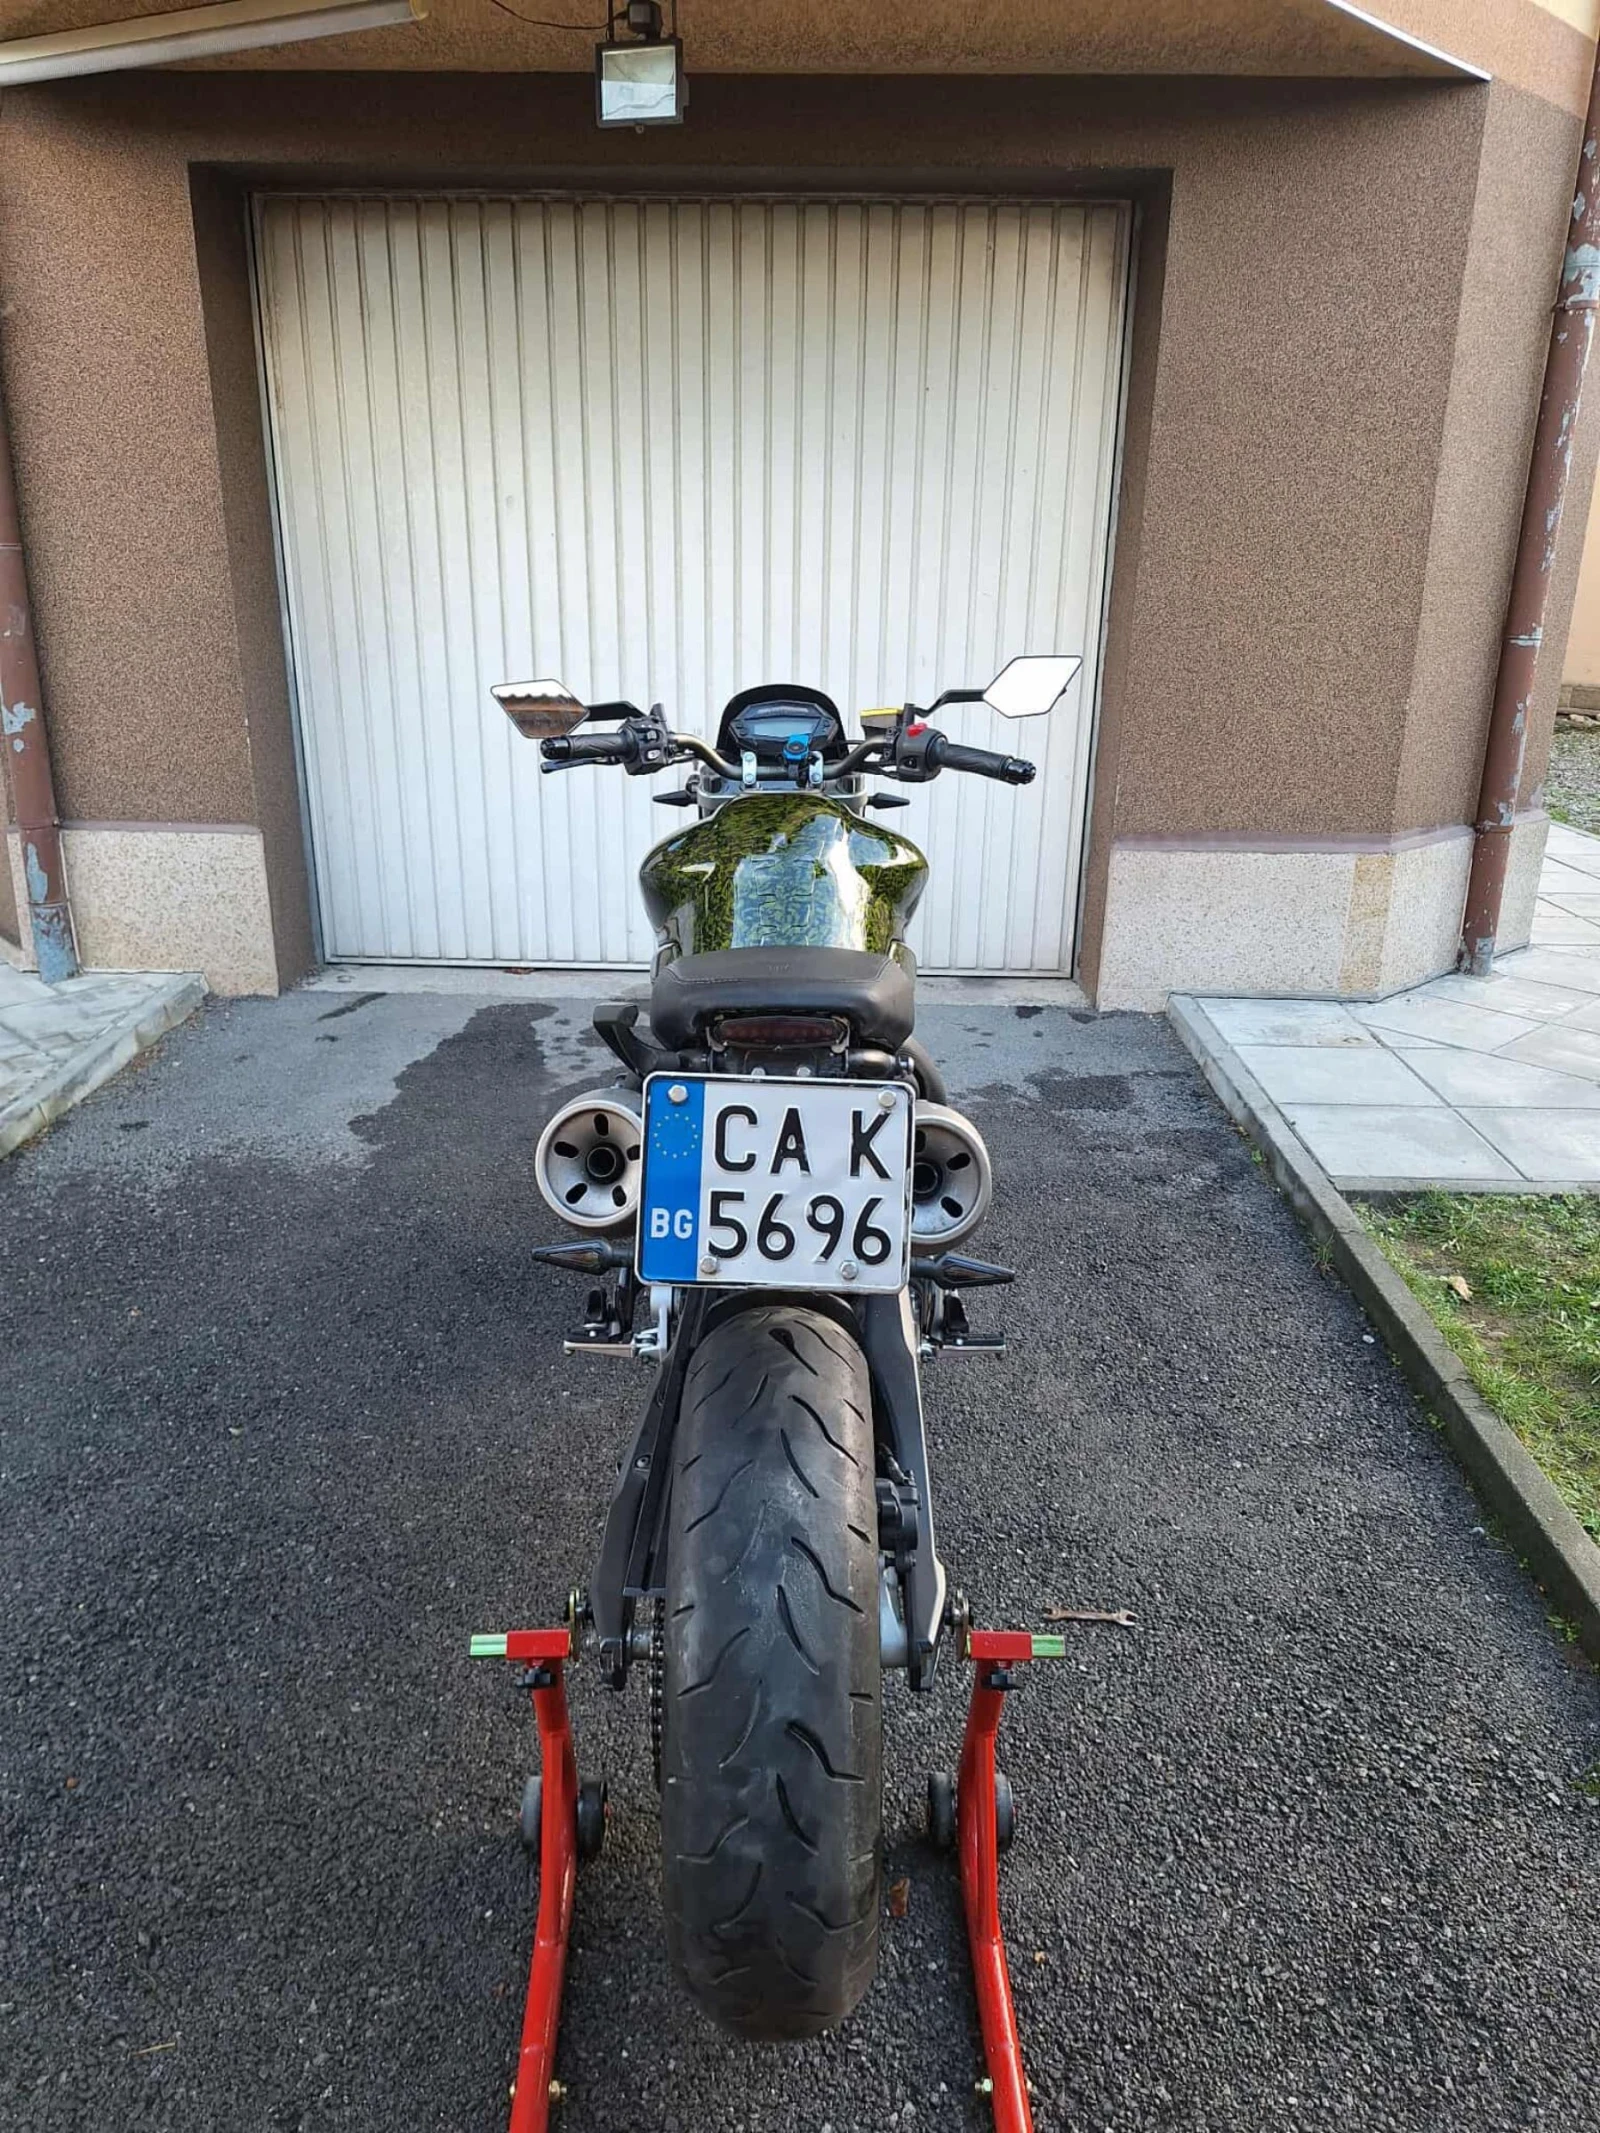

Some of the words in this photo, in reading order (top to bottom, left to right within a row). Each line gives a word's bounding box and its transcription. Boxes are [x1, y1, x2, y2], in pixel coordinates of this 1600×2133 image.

[714, 1104, 812, 1176] CA
[849, 1109, 892, 1180] K
[650, 1207, 693, 1240] BG
[707, 1190, 892, 1266] 5696
